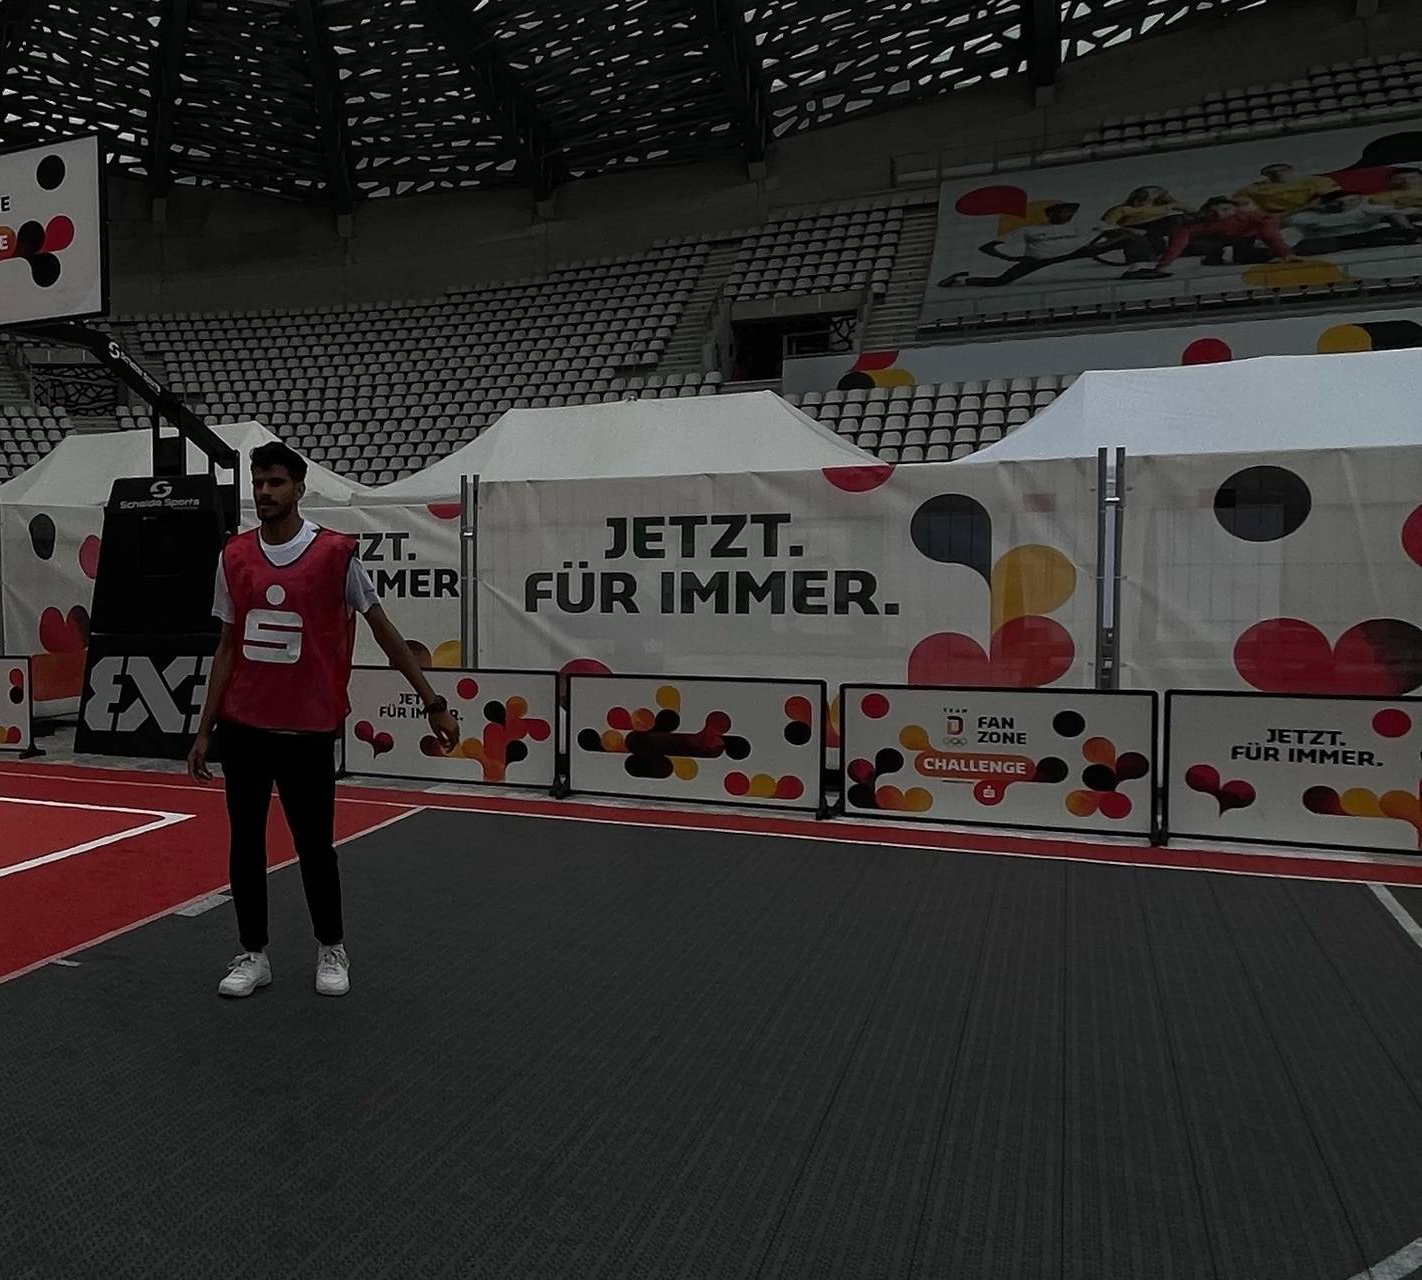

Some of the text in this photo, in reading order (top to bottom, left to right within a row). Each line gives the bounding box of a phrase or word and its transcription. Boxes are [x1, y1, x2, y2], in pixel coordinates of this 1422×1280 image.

[605, 513, 804, 559] JETZT.
[524, 561, 900, 615] FÜR IMMER.
[379, 703, 407, 718] FÜR
[978, 716, 1015, 730] FAN
[977, 731, 1028, 745] ZONE
[1266, 728, 1347, 746] JETZT.
[1230, 742, 1384, 767] FÜR IMMER.
[923, 757, 1028, 775] CHALLENGE
